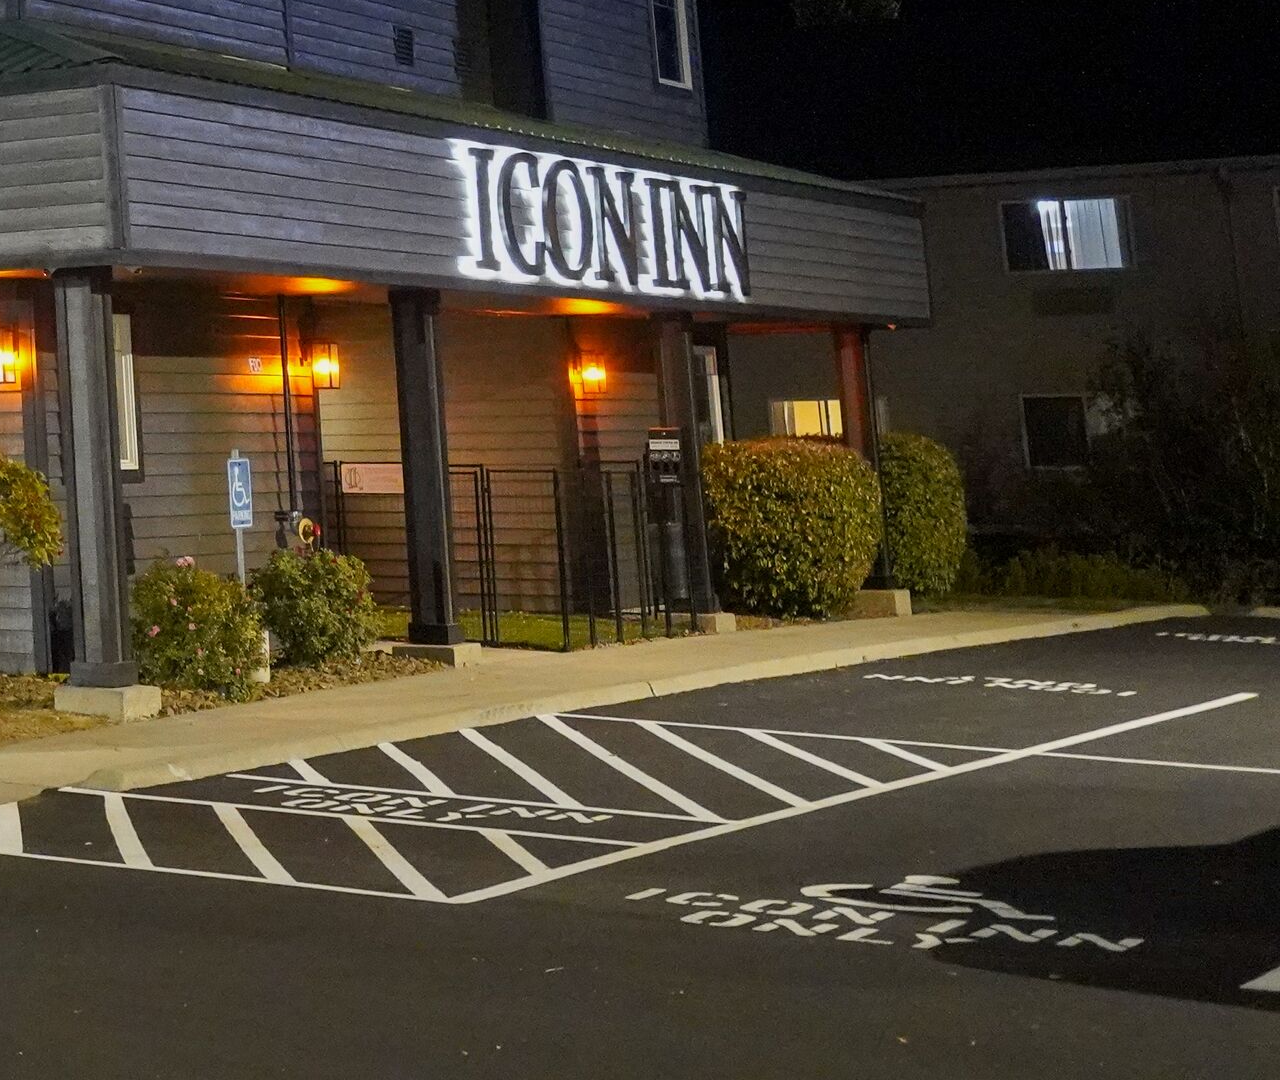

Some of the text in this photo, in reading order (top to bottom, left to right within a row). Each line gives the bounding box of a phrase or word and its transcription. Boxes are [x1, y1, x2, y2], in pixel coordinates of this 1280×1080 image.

[468, 148, 751, 296] ICON INN
[253, 785, 613, 823] ICON INN
[281, 799, 487, 821] ONLY
[625, 888, 1144, 951] ICON INN
[680, 910, 975, 949] ONLY
